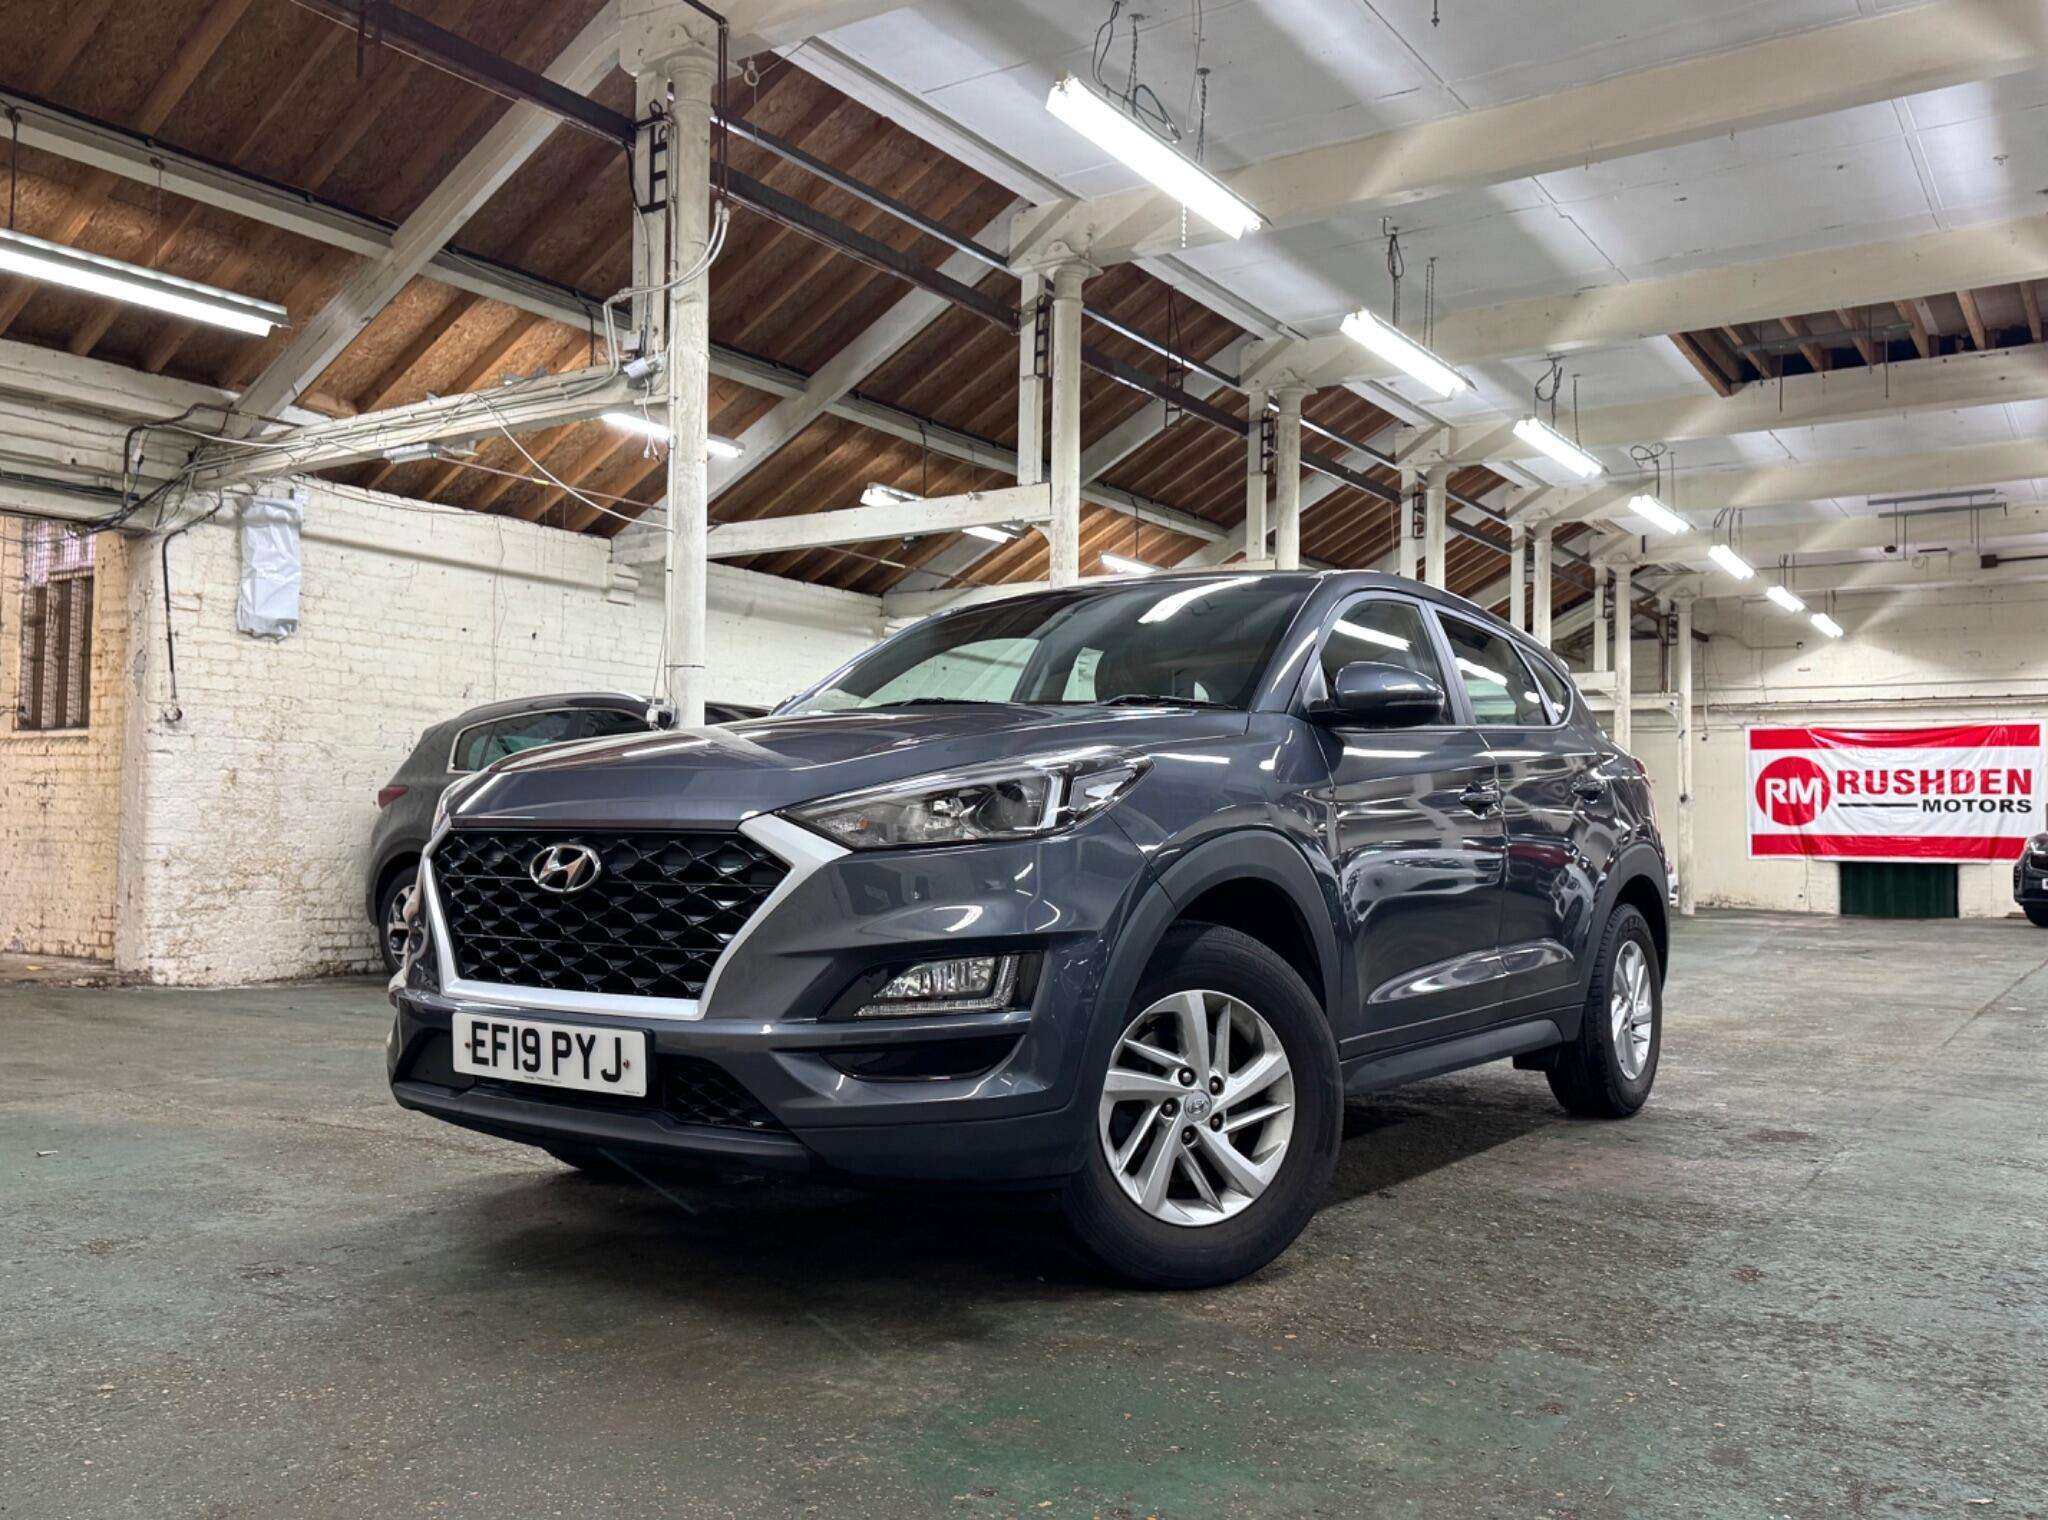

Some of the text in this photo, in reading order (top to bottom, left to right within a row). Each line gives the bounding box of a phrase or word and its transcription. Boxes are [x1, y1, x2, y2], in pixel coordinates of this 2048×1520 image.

[1765, 776, 1823, 820] RM
[1837, 769, 2033, 795] RUSHDEN
[1922, 799, 2033, 813] MOTORS
[471, 1021, 542, 1073] EF19
